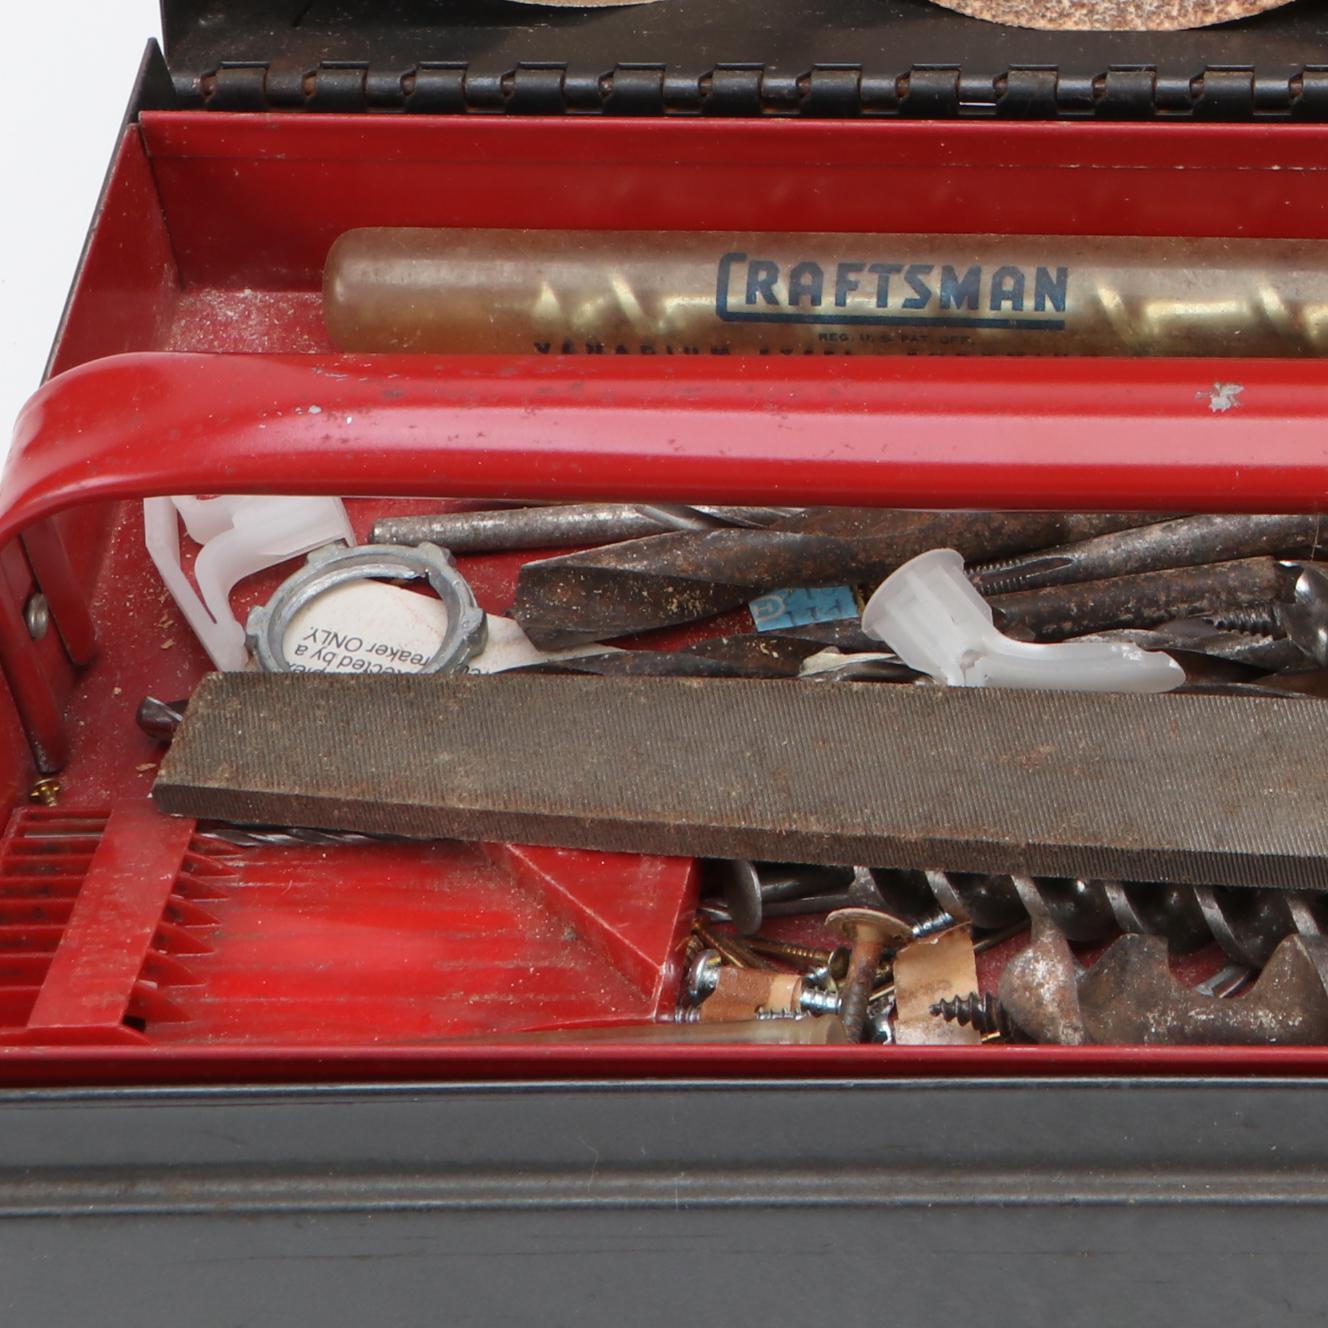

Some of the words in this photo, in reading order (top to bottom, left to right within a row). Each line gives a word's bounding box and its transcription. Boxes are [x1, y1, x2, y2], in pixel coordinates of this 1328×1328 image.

[716, 252, 1069, 328] CRAFTSMAN
[294, 644, 309, 656] a
[303, 626, 364, 652] ONLY.
[311, 646, 337, 666] by
[366, 642, 433, 667] reaker
